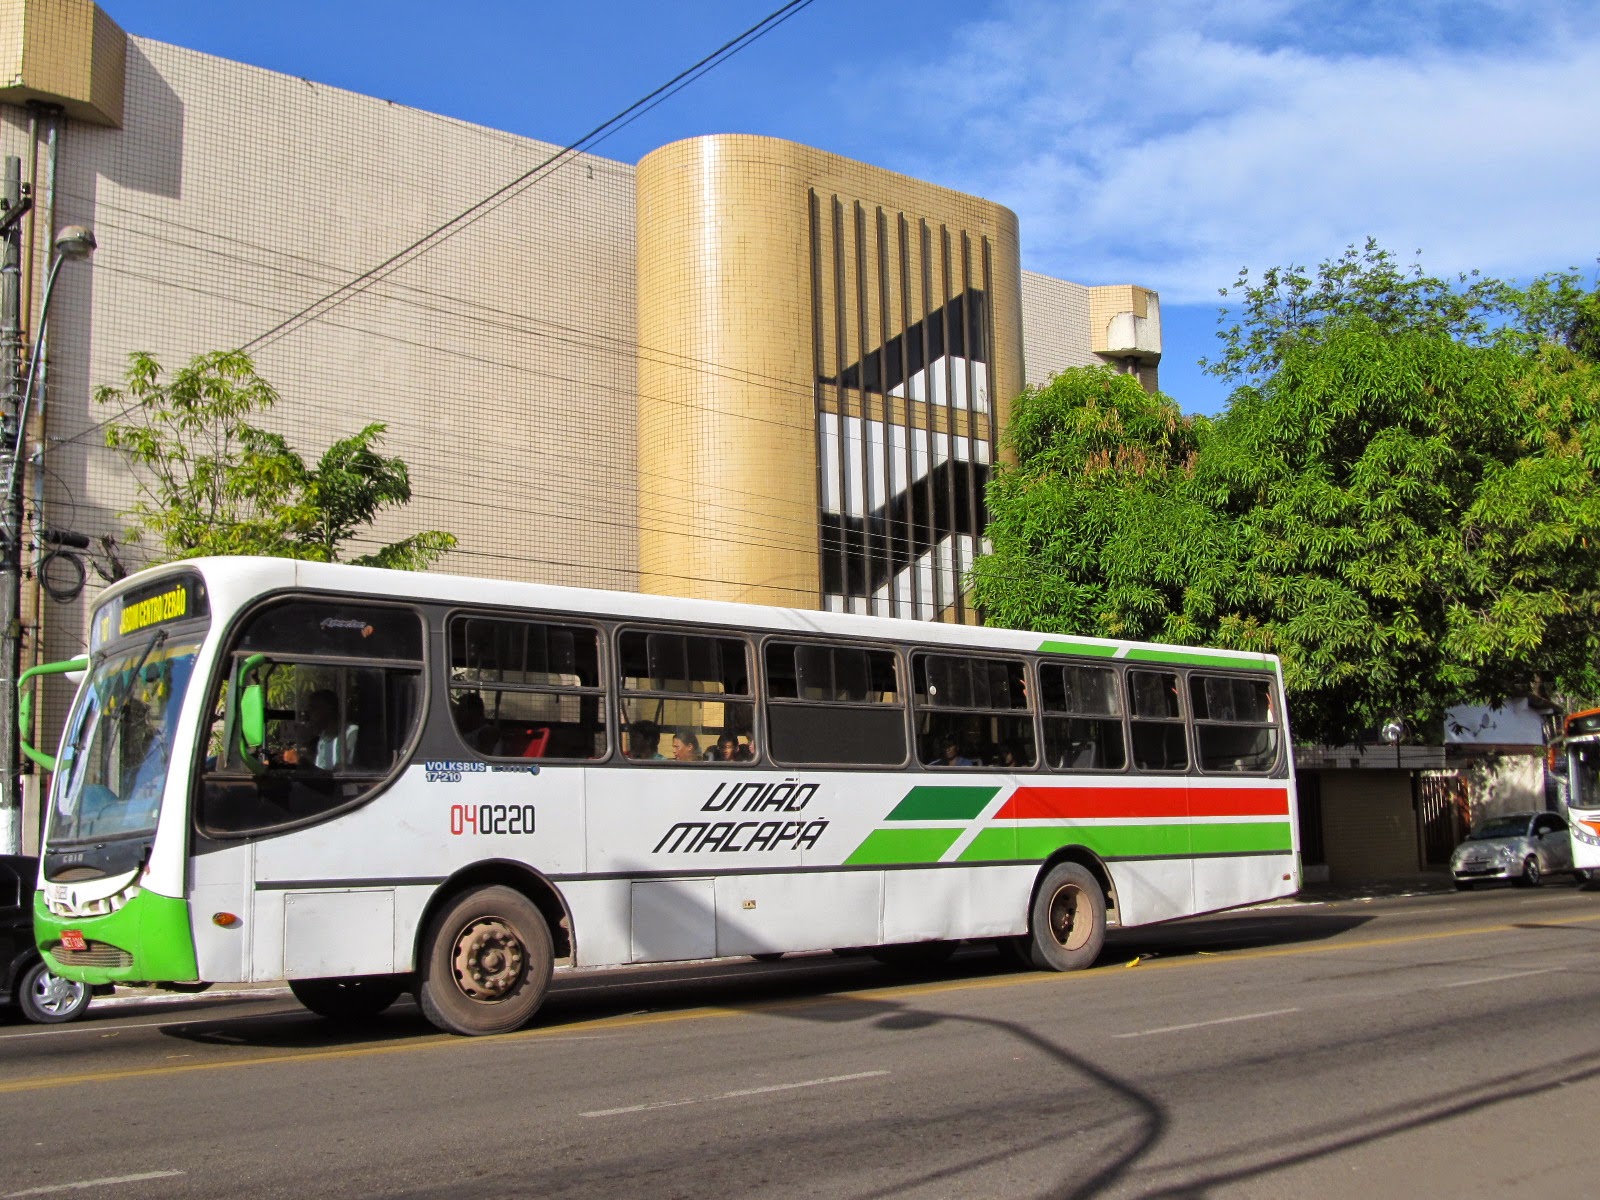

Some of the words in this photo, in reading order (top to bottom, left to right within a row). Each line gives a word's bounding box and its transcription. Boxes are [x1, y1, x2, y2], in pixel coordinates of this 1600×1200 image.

[426, 761, 486, 771] VOLKSBUS
[426, 772, 461, 782] 17-210
[700, 778, 820, 811] UNIÃO
[652, 817, 830, 853] MACAPÁ
